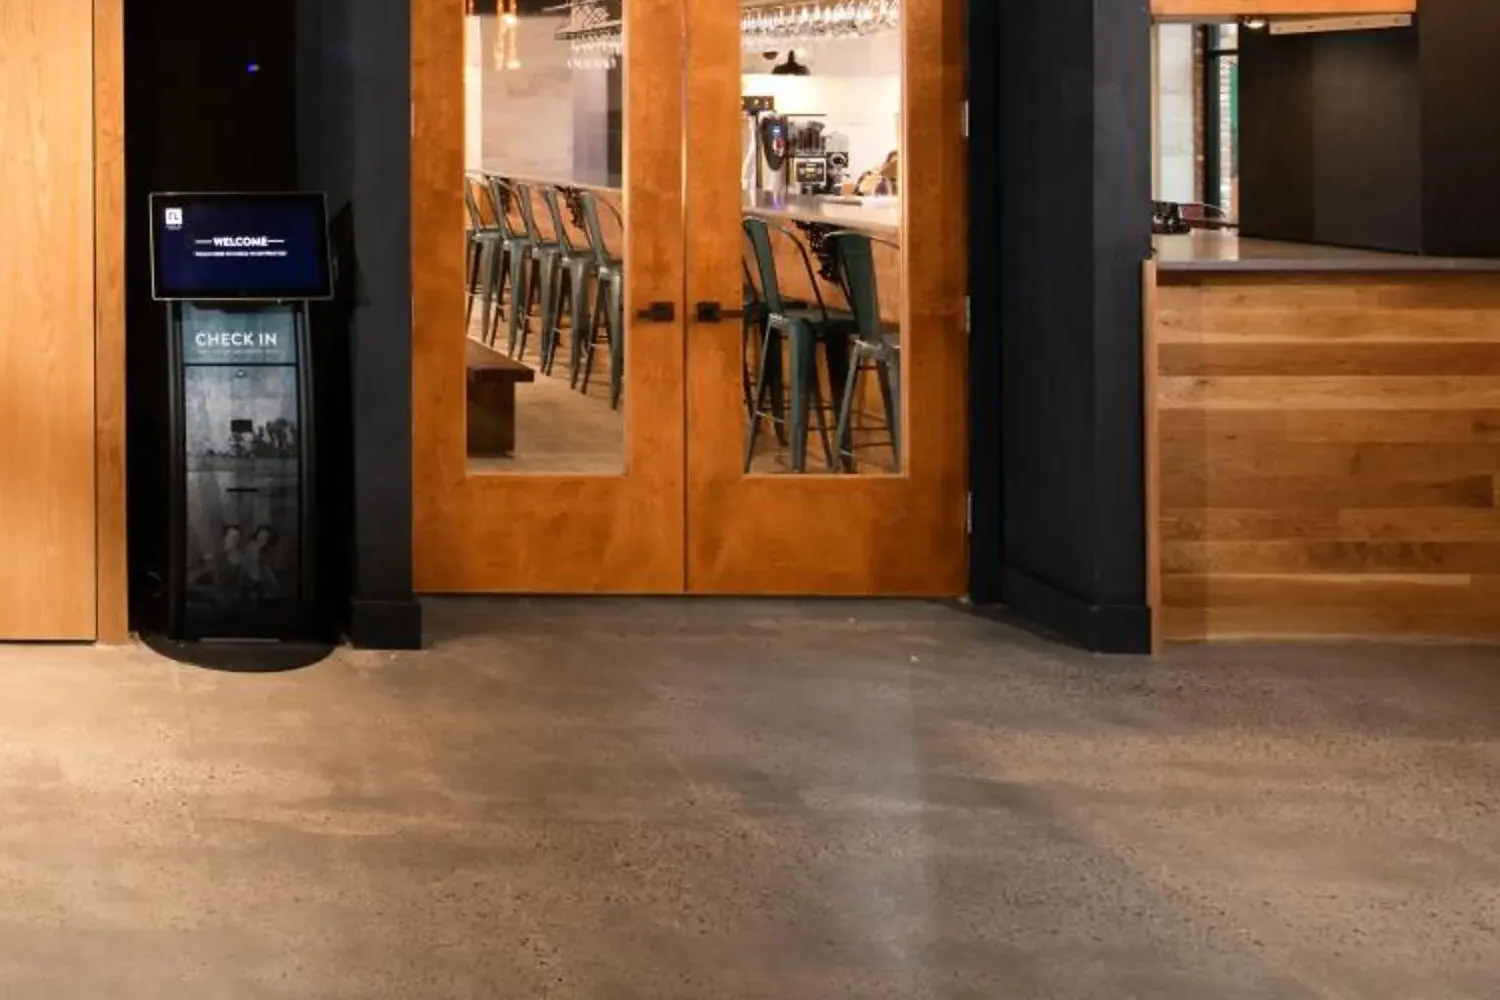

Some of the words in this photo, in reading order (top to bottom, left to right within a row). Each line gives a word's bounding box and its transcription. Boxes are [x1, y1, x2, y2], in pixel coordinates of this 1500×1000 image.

[213, 236, 269, 247] WELCOME
[195, 332, 254, 347] CHECK
[259, 332, 278, 346] IN
